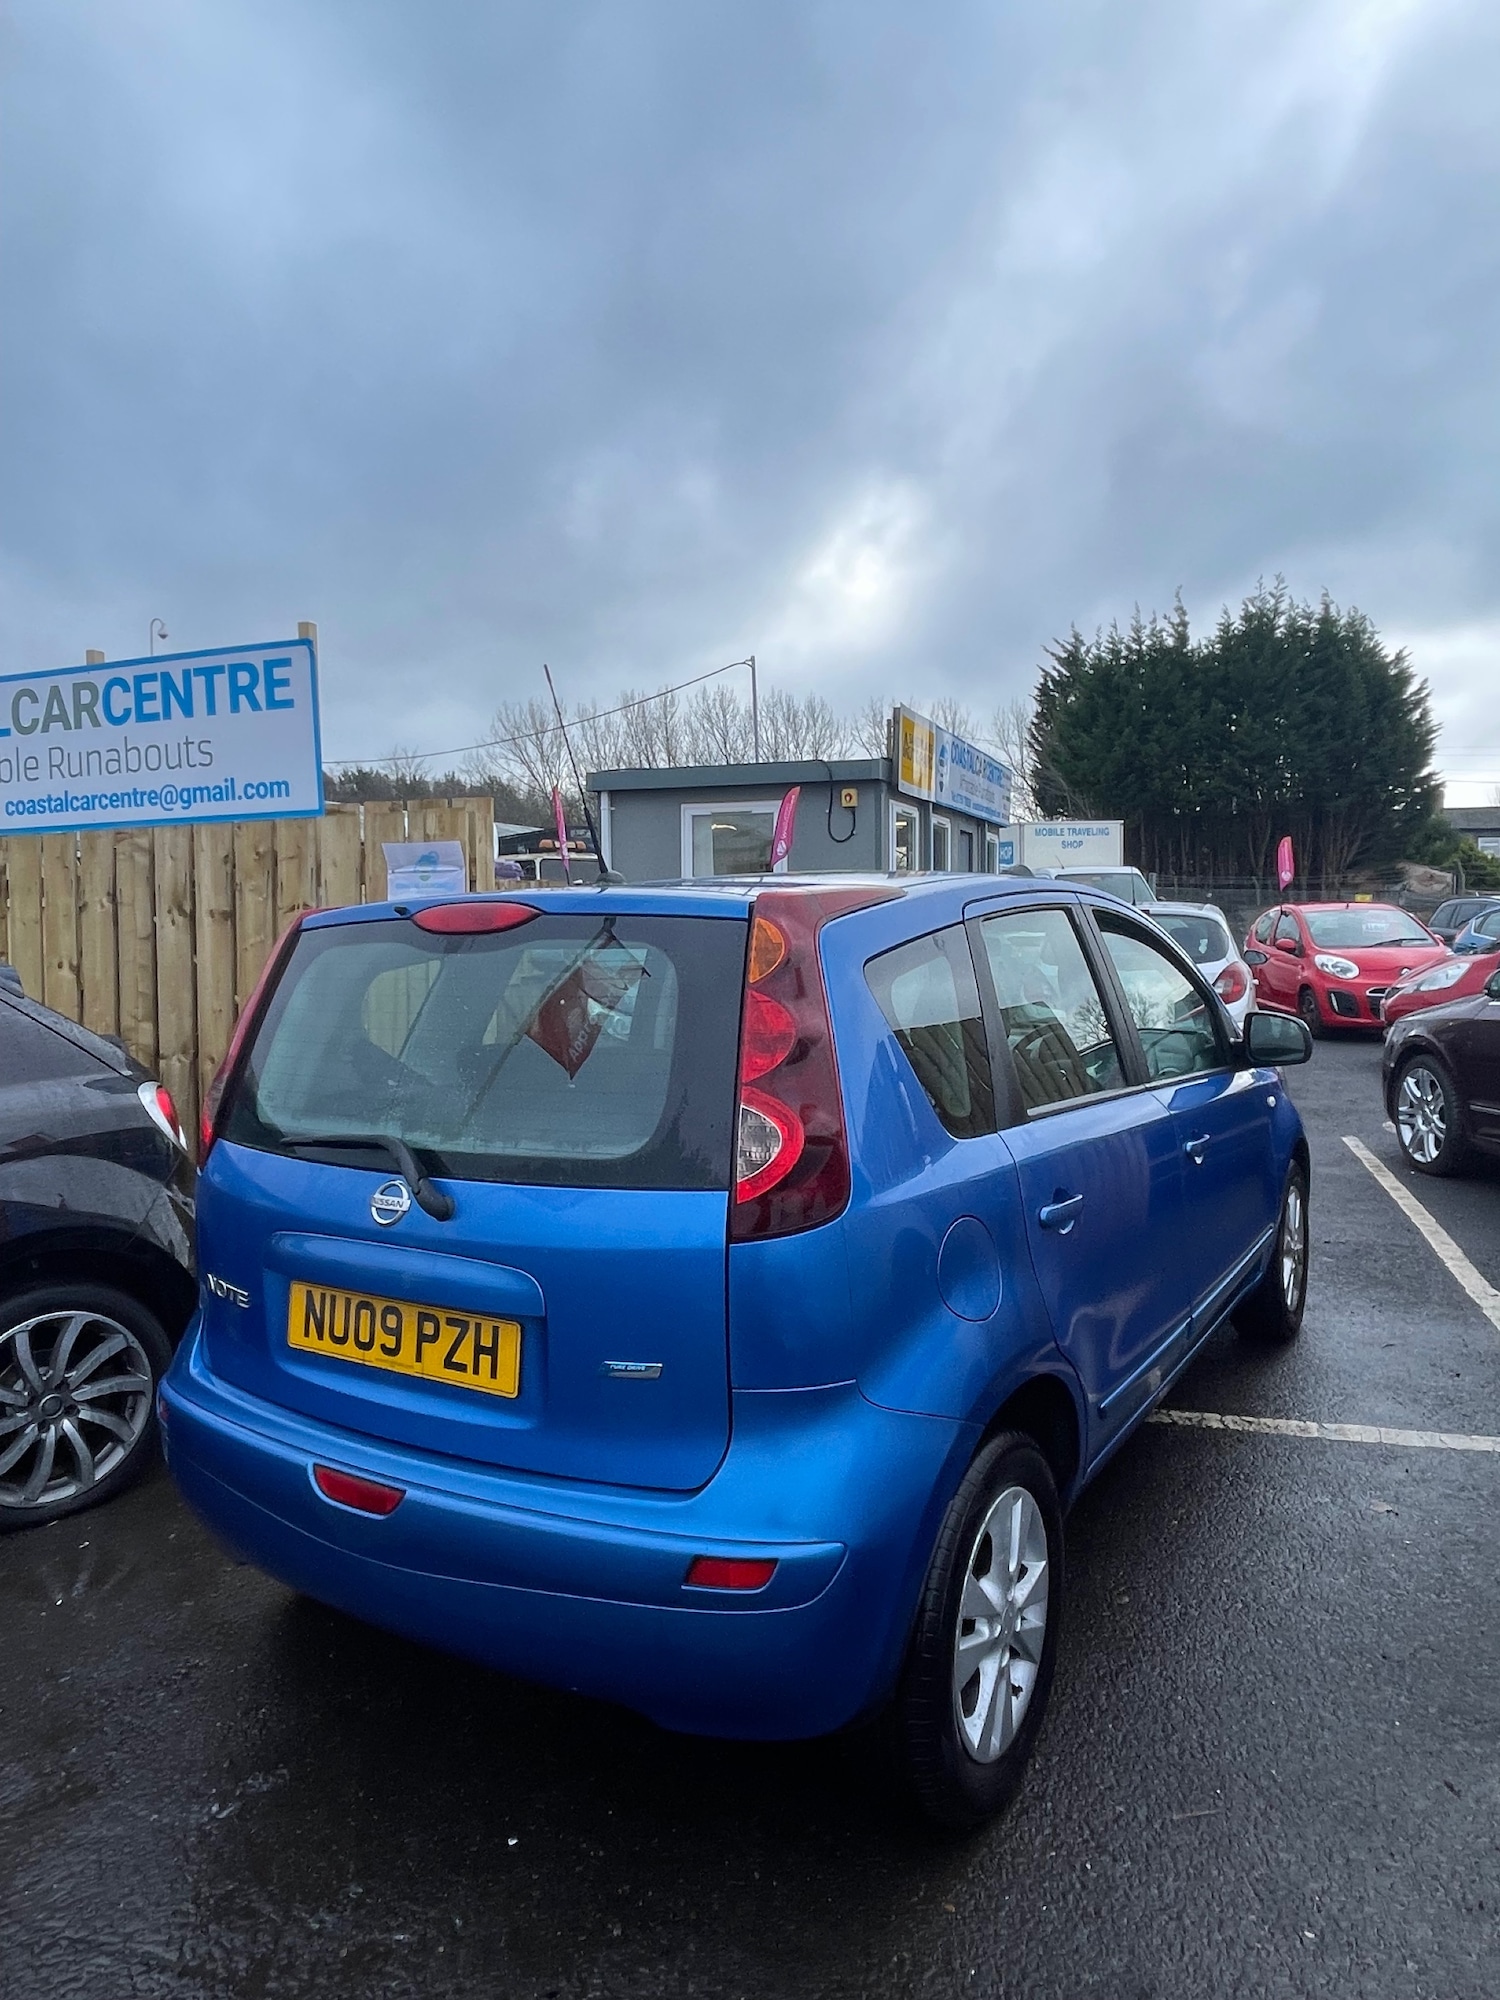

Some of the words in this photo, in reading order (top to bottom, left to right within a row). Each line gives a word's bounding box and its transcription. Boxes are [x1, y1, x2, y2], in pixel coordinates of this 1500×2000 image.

[49, 735, 213, 780] Runabouts
[5, 777, 290, 816] coastalcarcentre@gmail.com
[1035, 827, 1065, 837] MOBILE
[1067, 826, 1110, 837] TRAVELING
[1061, 840, 1084, 849] SHOP
[207, 1273, 250, 1308] NOTE
[304, 1289, 404, 1357] NU09
[415, 1311, 500, 1380] PZH
